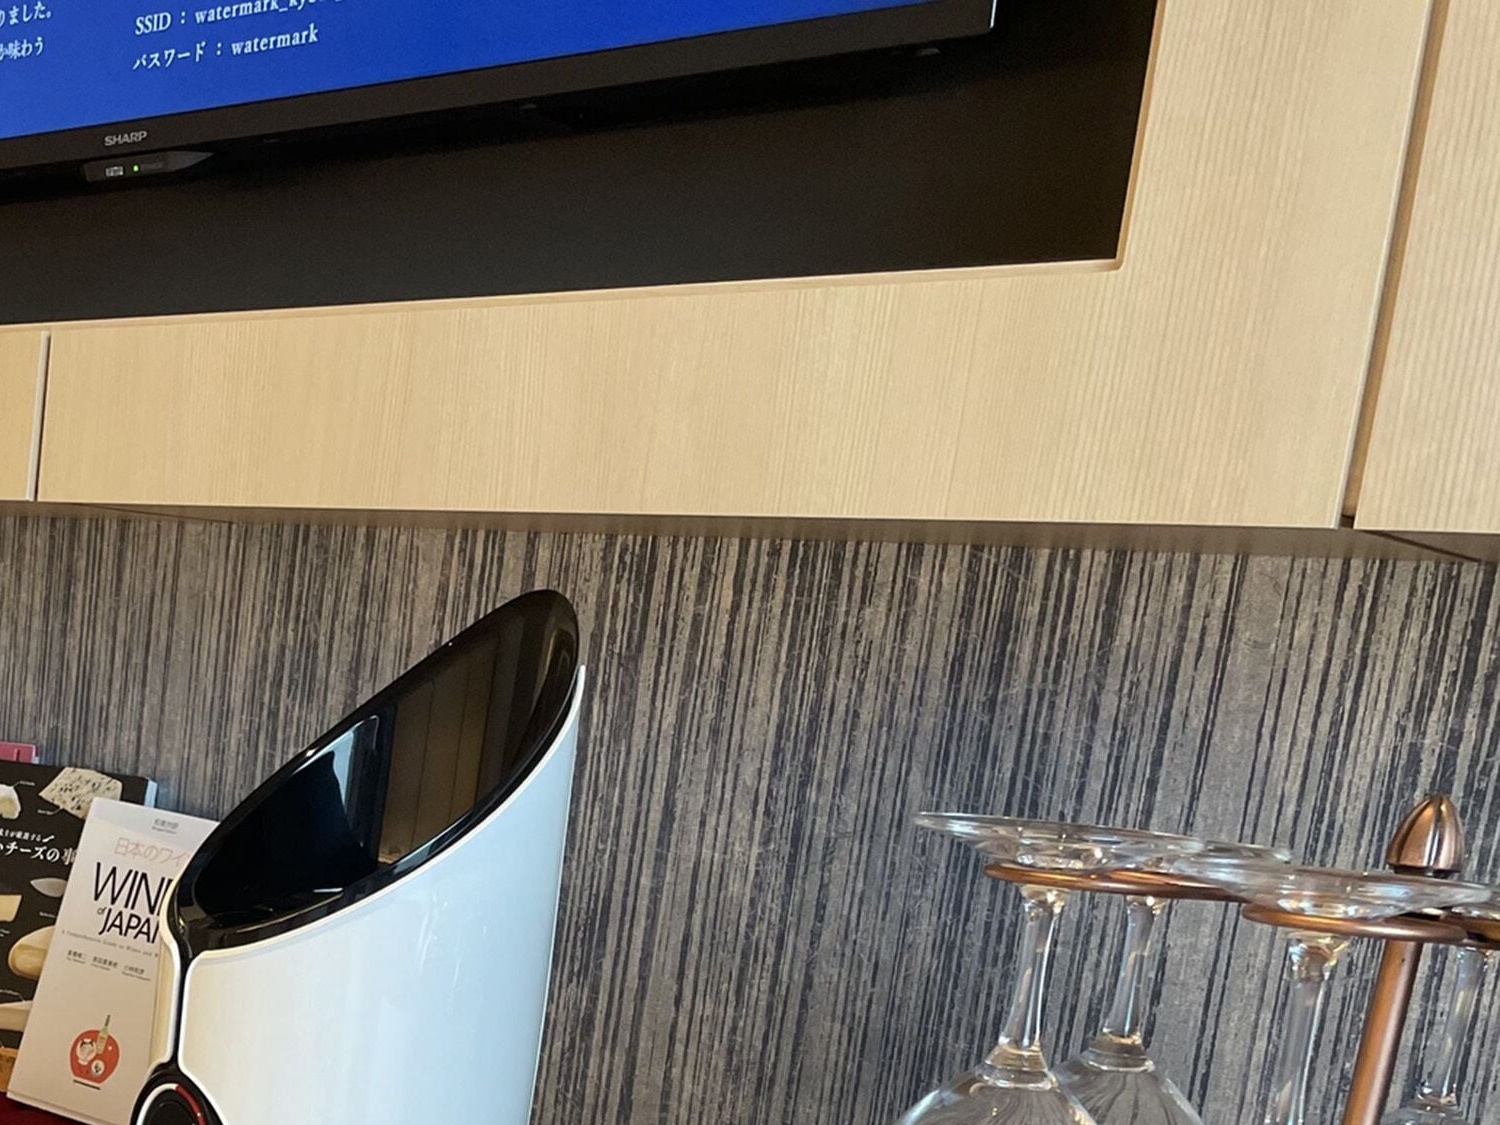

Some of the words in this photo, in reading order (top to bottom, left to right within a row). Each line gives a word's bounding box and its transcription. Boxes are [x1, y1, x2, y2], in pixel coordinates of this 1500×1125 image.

[134, 11, 172, 35] SSID
[231, 23, 319, 56] watermark
[104, 131, 148, 146] SHARP
[97, 906, 108, 916] of
